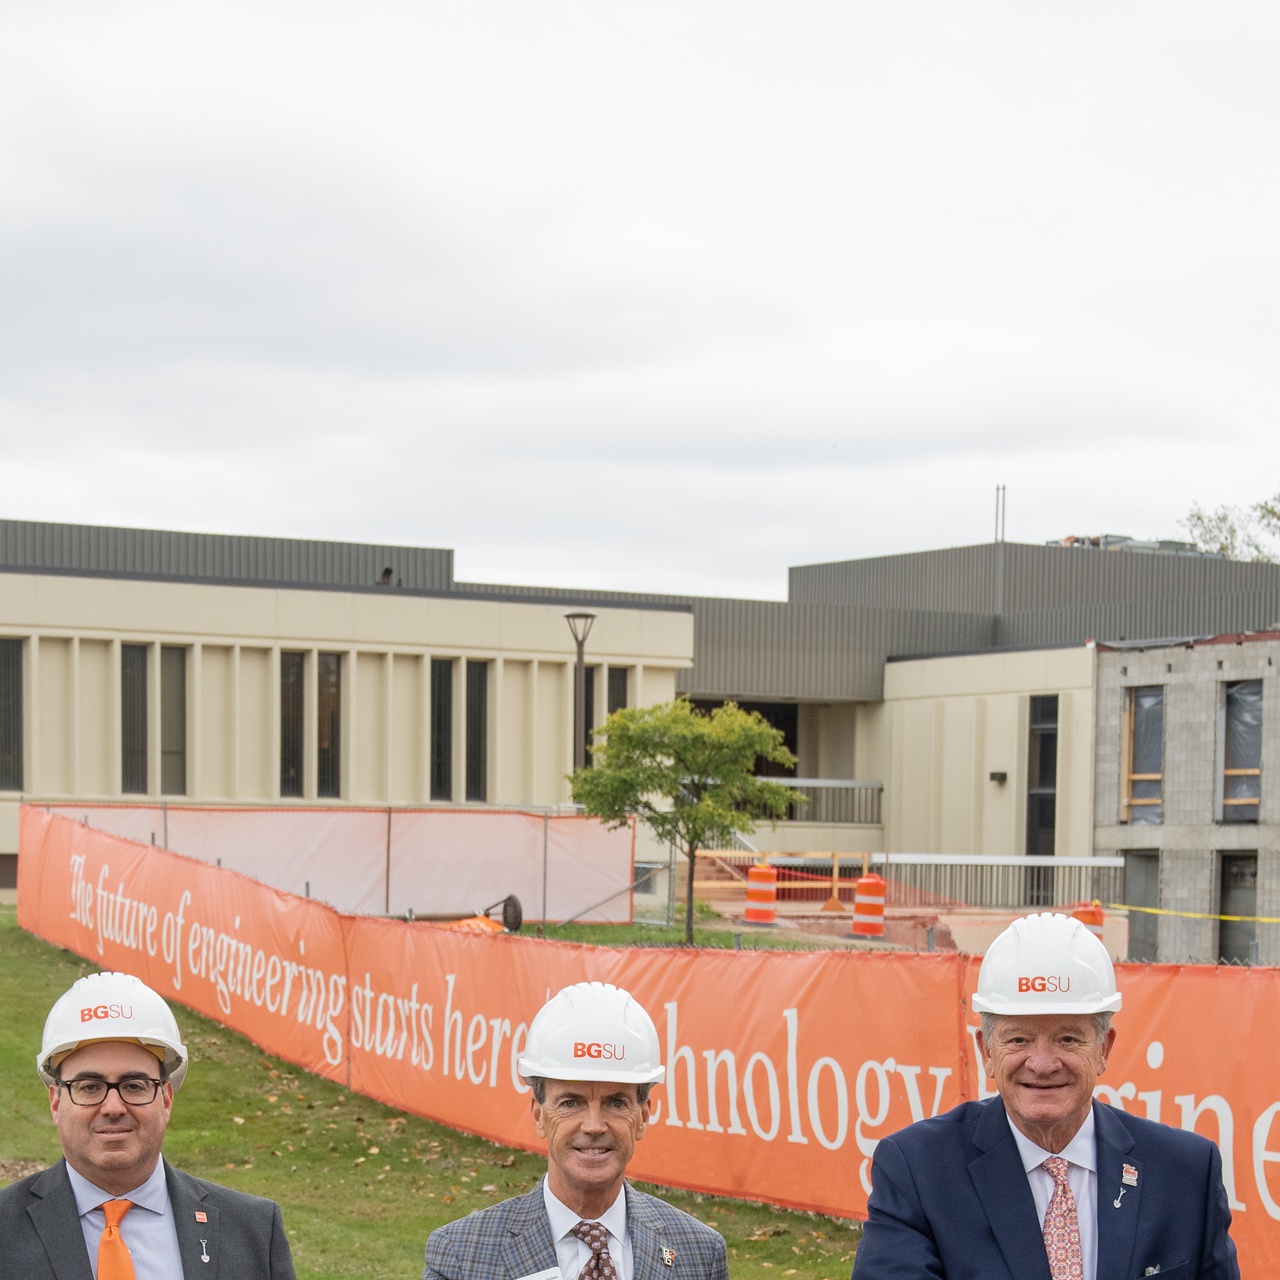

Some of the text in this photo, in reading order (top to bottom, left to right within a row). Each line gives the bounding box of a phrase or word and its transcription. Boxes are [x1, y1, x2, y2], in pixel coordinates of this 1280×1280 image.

[70, 854, 532, 1094] The future of engineering starts here
[1018, 976, 1071, 993] BGSU
[81, 1004, 134, 1023] BGSU
[573, 1043, 625, 1060] BGSU
[546, 987, 953, 1196] hnology
